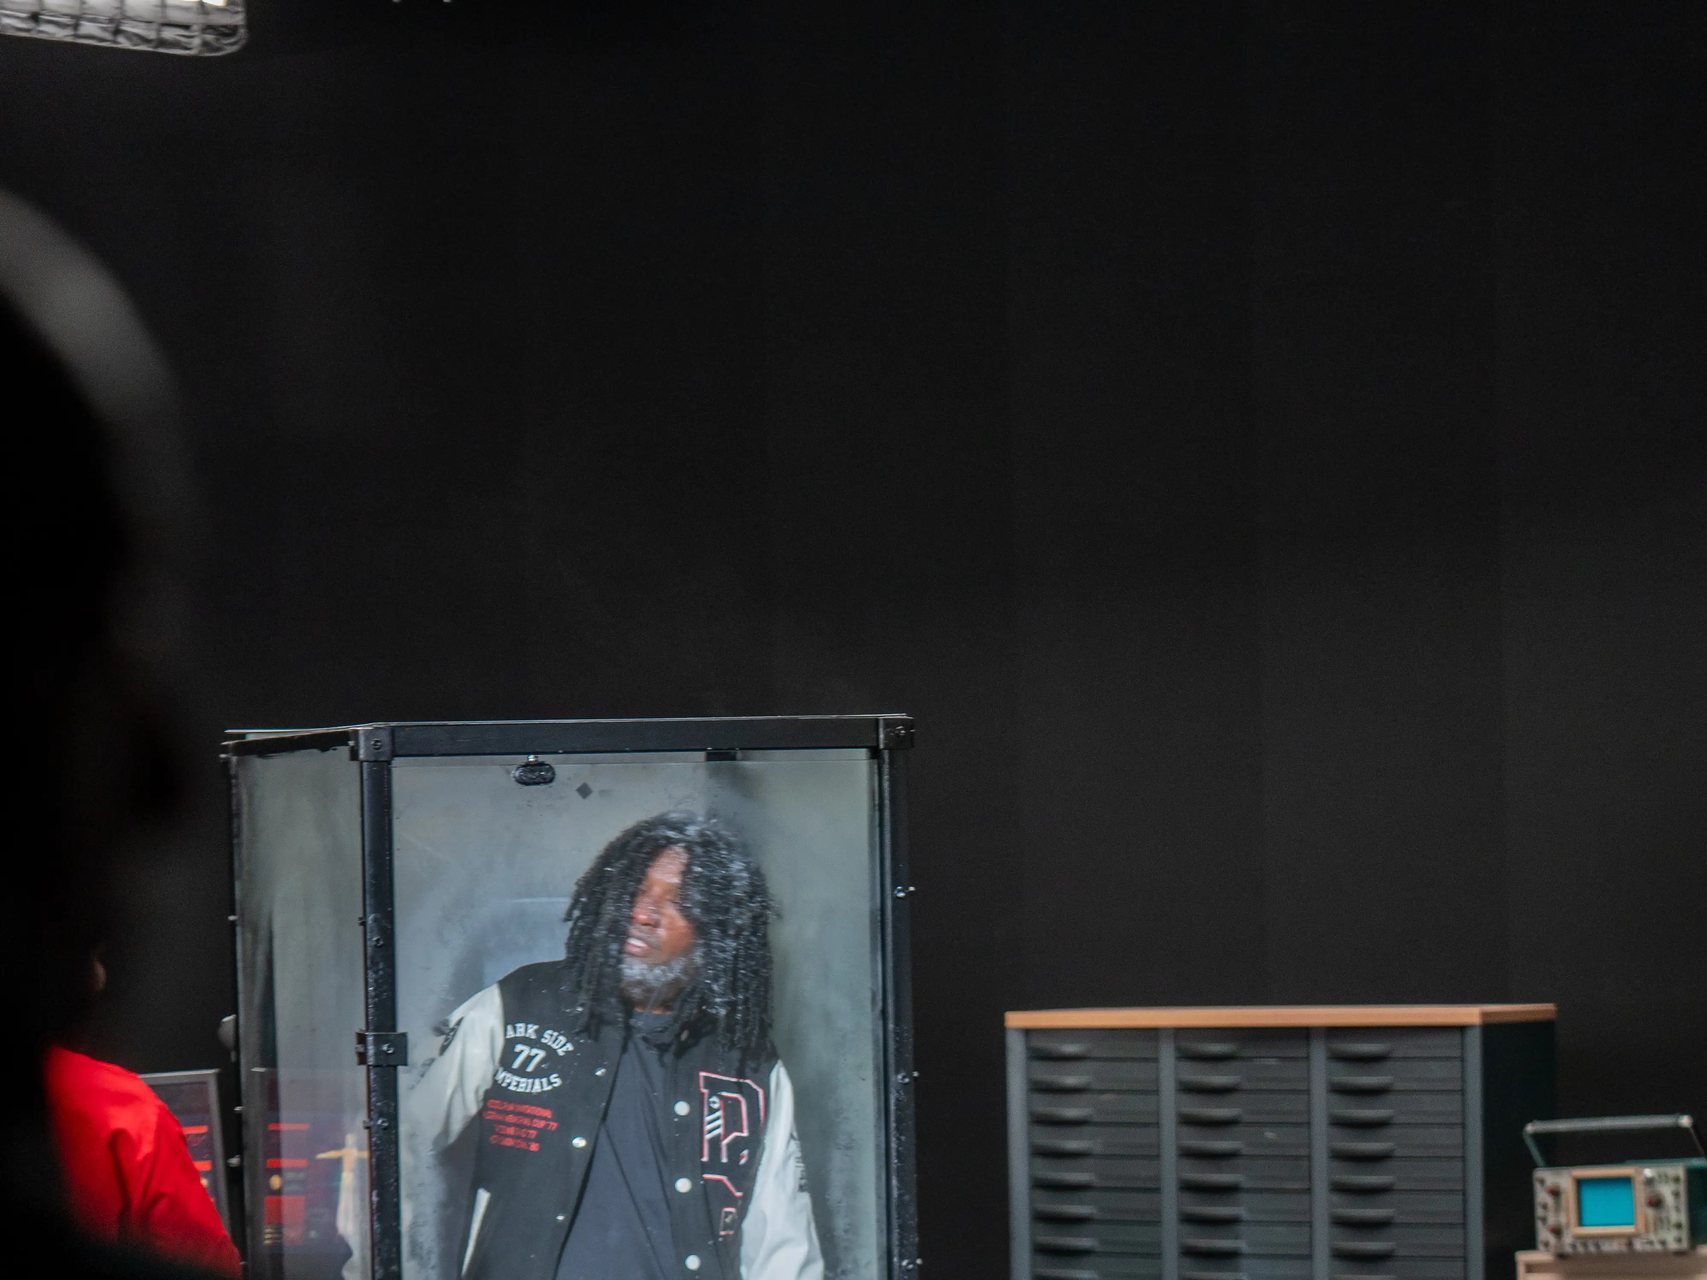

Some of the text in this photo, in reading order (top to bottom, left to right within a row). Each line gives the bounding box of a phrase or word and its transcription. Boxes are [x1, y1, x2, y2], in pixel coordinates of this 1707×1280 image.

[505, 1023, 575, 1056] ARK SIDE
[511, 1043, 546, 1073] 77
